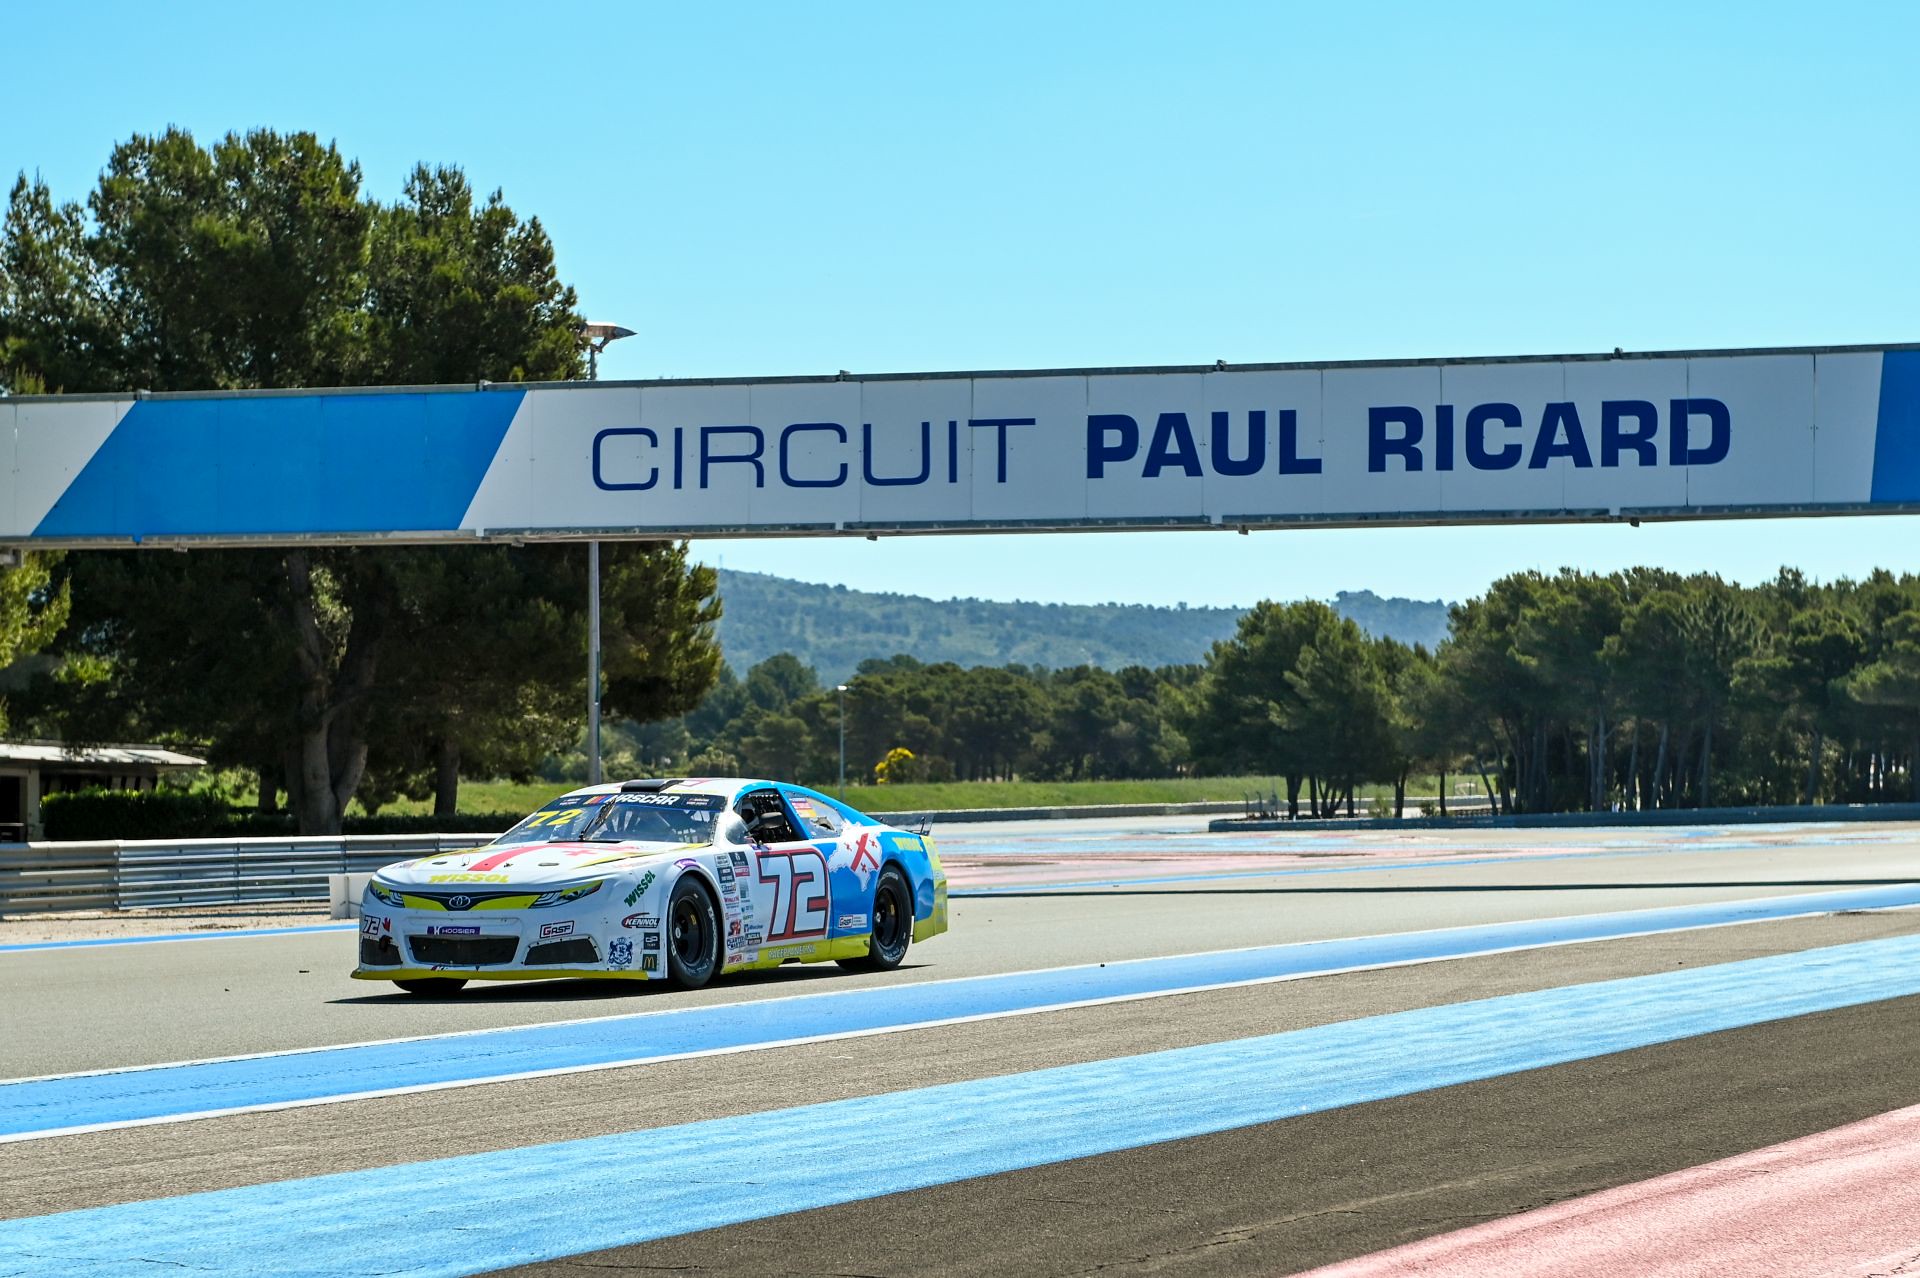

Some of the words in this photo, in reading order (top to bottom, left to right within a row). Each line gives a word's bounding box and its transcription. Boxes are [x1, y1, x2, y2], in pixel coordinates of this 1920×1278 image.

[592, 418, 1036, 491] CIRCUIT
[1086, 409, 1322, 479] PAUL
[1367, 398, 1731, 473] RICARD
[604, 794, 680, 805] NASCAR
[527, 808, 583, 828] 72
[428, 873, 510, 885] WISSOL
[624, 870, 656, 907] WISSOL
[755, 848, 829, 941] 72
[362, 915, 380, 935] 72
[543, 923, 572, 936] GASF
[625, 918, 658, 926] KENNOL
